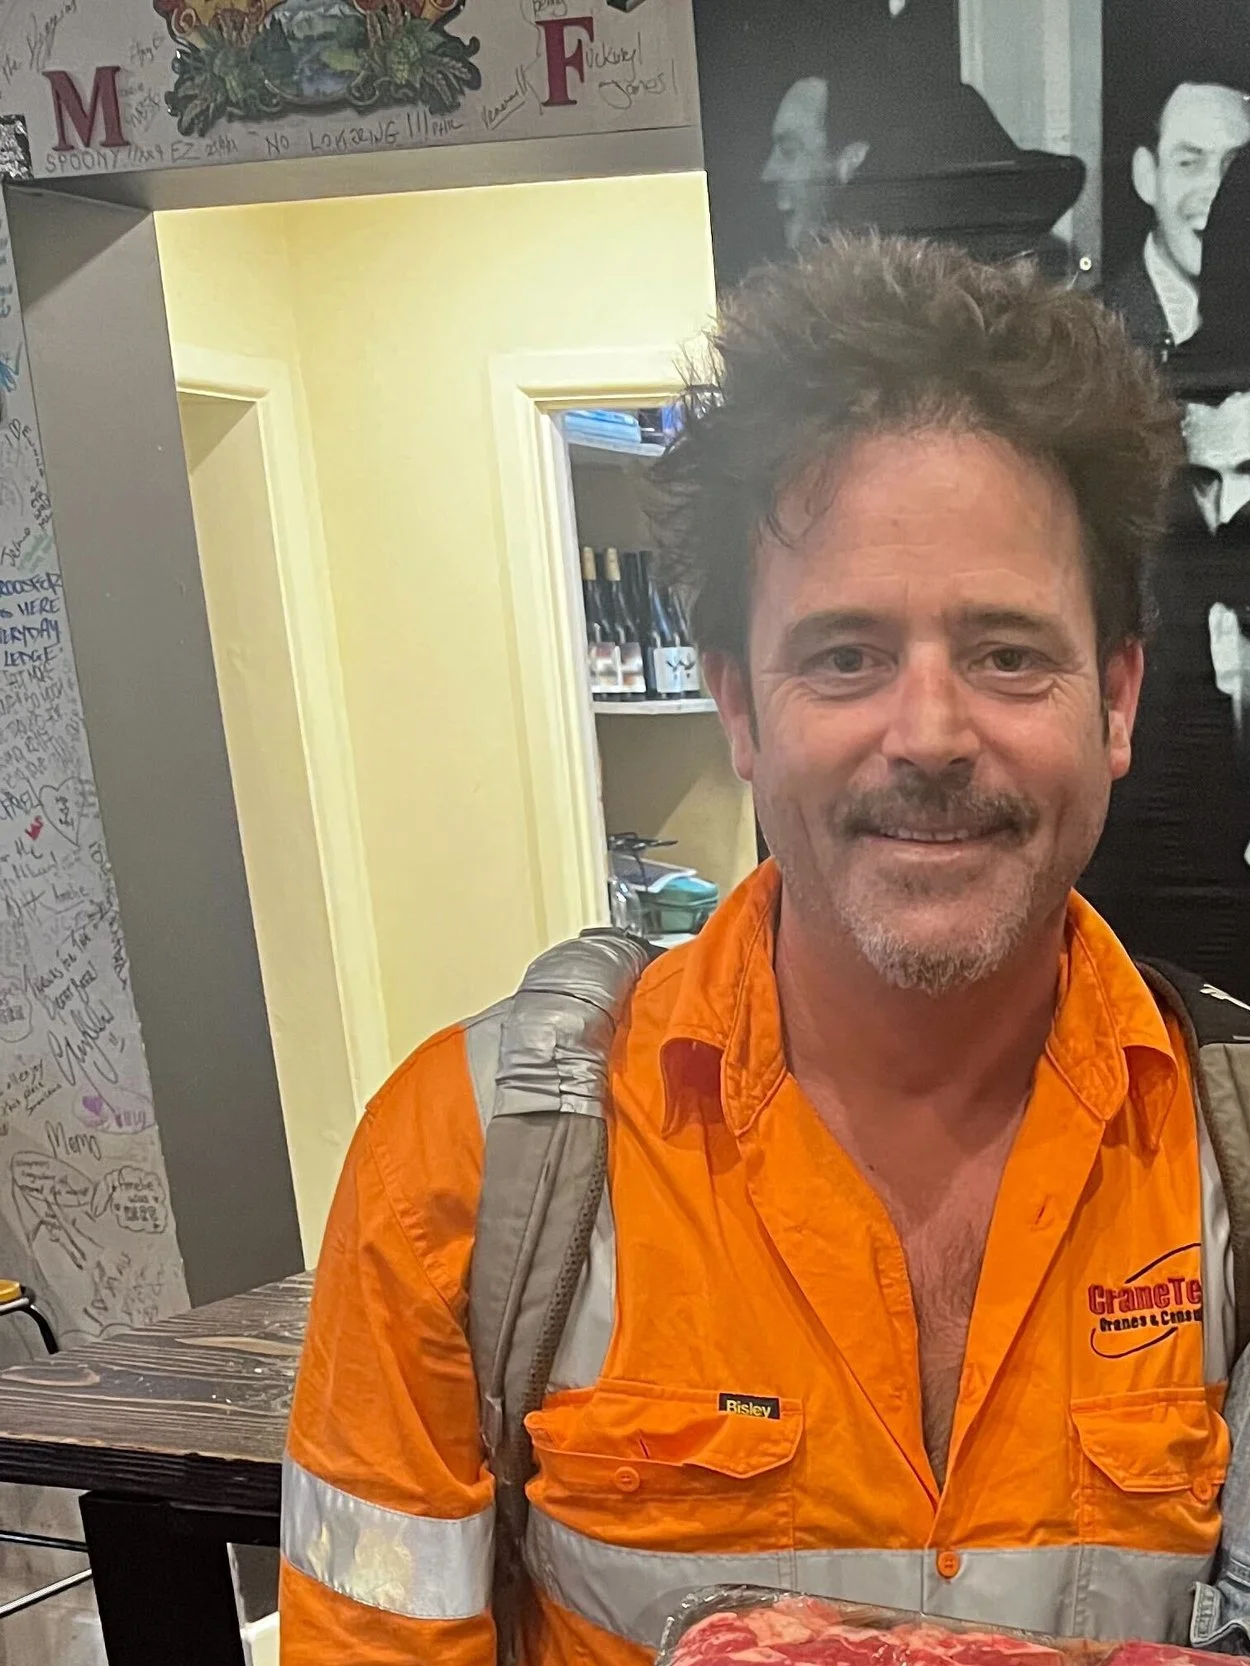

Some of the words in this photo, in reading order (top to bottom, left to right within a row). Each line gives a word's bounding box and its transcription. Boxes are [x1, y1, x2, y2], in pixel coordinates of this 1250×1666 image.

[41, 65, 131, 151] M
[1099, 1315, 1147, 1332] Cranes
[1150, 1314, 1159, 1327] &
[726, 1399, 771, 1418] Bisley
